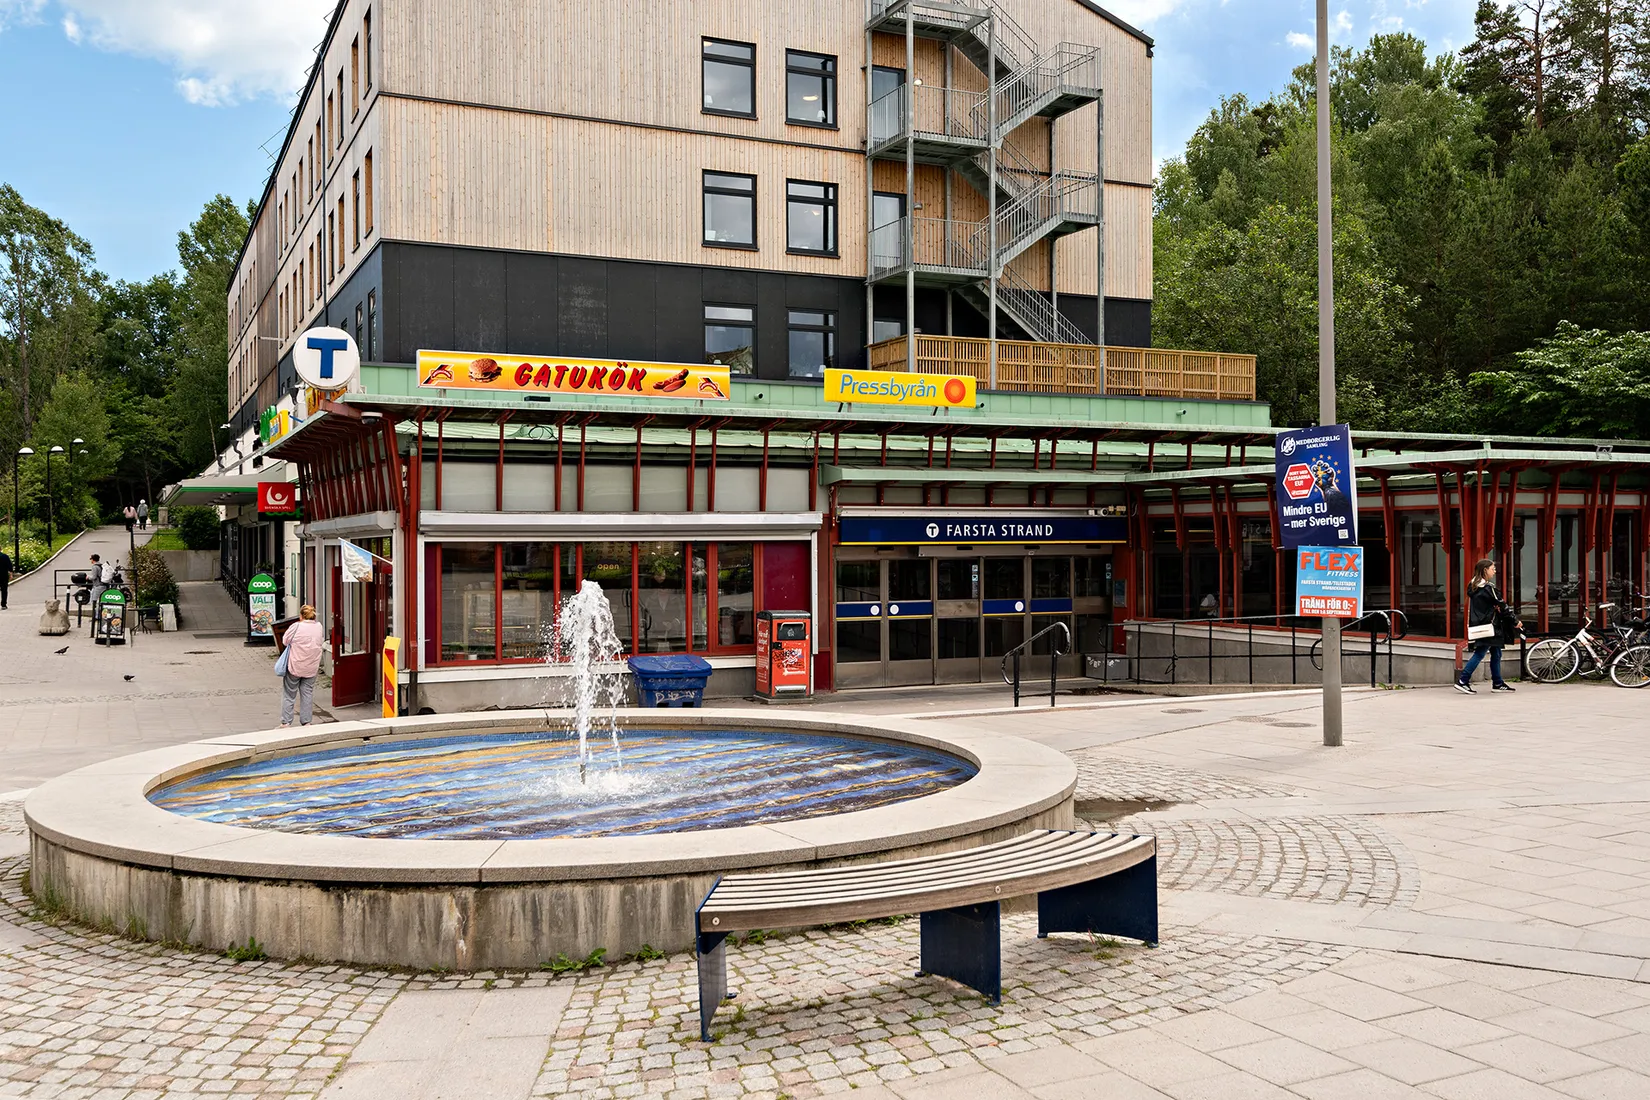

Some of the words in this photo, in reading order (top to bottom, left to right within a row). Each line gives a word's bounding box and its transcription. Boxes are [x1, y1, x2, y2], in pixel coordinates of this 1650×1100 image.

[307, 337, 348, 379] T
[514, 361, 647, 392] GATUKÖK
[840, 373, 937, 401] Pressbyrån
[1296, 435, 1341, 446] MEDBORGERLIG
[1283, 504, 1313, 517] Mindre
[1314, 502, 1328, 514] EU
[1291, 519, 1307, 528] mer
[1309, 514, 1346, 527] Sverige
[946, 524, 996, 537] FARSTA
[1001, 524, 1053, 537] STRAND
[597, 563, 620, 571] open
[1300, 552, 1359, 572] FLEX
[1301, 597, 1326, 609] TRÄNA
[1327, 598, 1341, 609] FÖR
